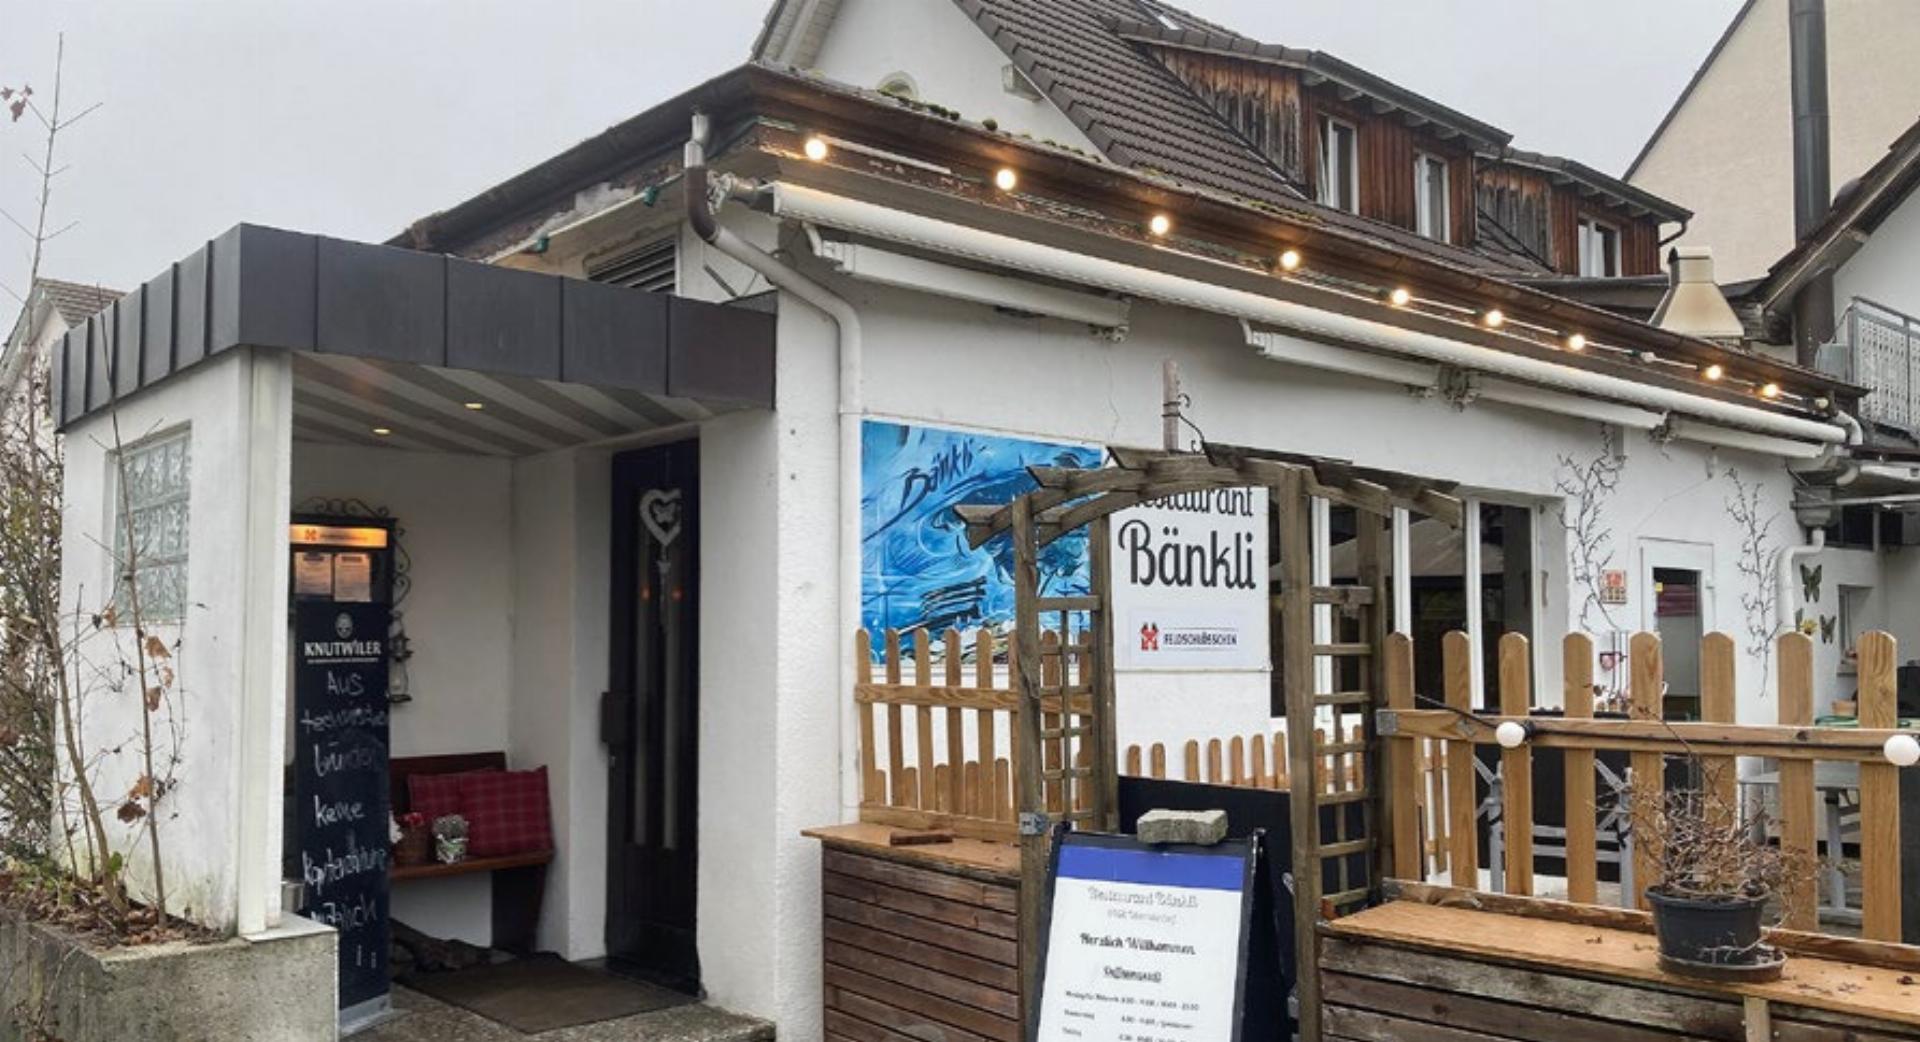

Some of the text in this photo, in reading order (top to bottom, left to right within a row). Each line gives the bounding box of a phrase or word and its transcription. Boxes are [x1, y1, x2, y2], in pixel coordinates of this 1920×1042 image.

[900, 438, 974, 512] Bänkli
[1118, 519, 1257, 589] Bänkli
[304, 640, 381, 657] KNUTWILER
